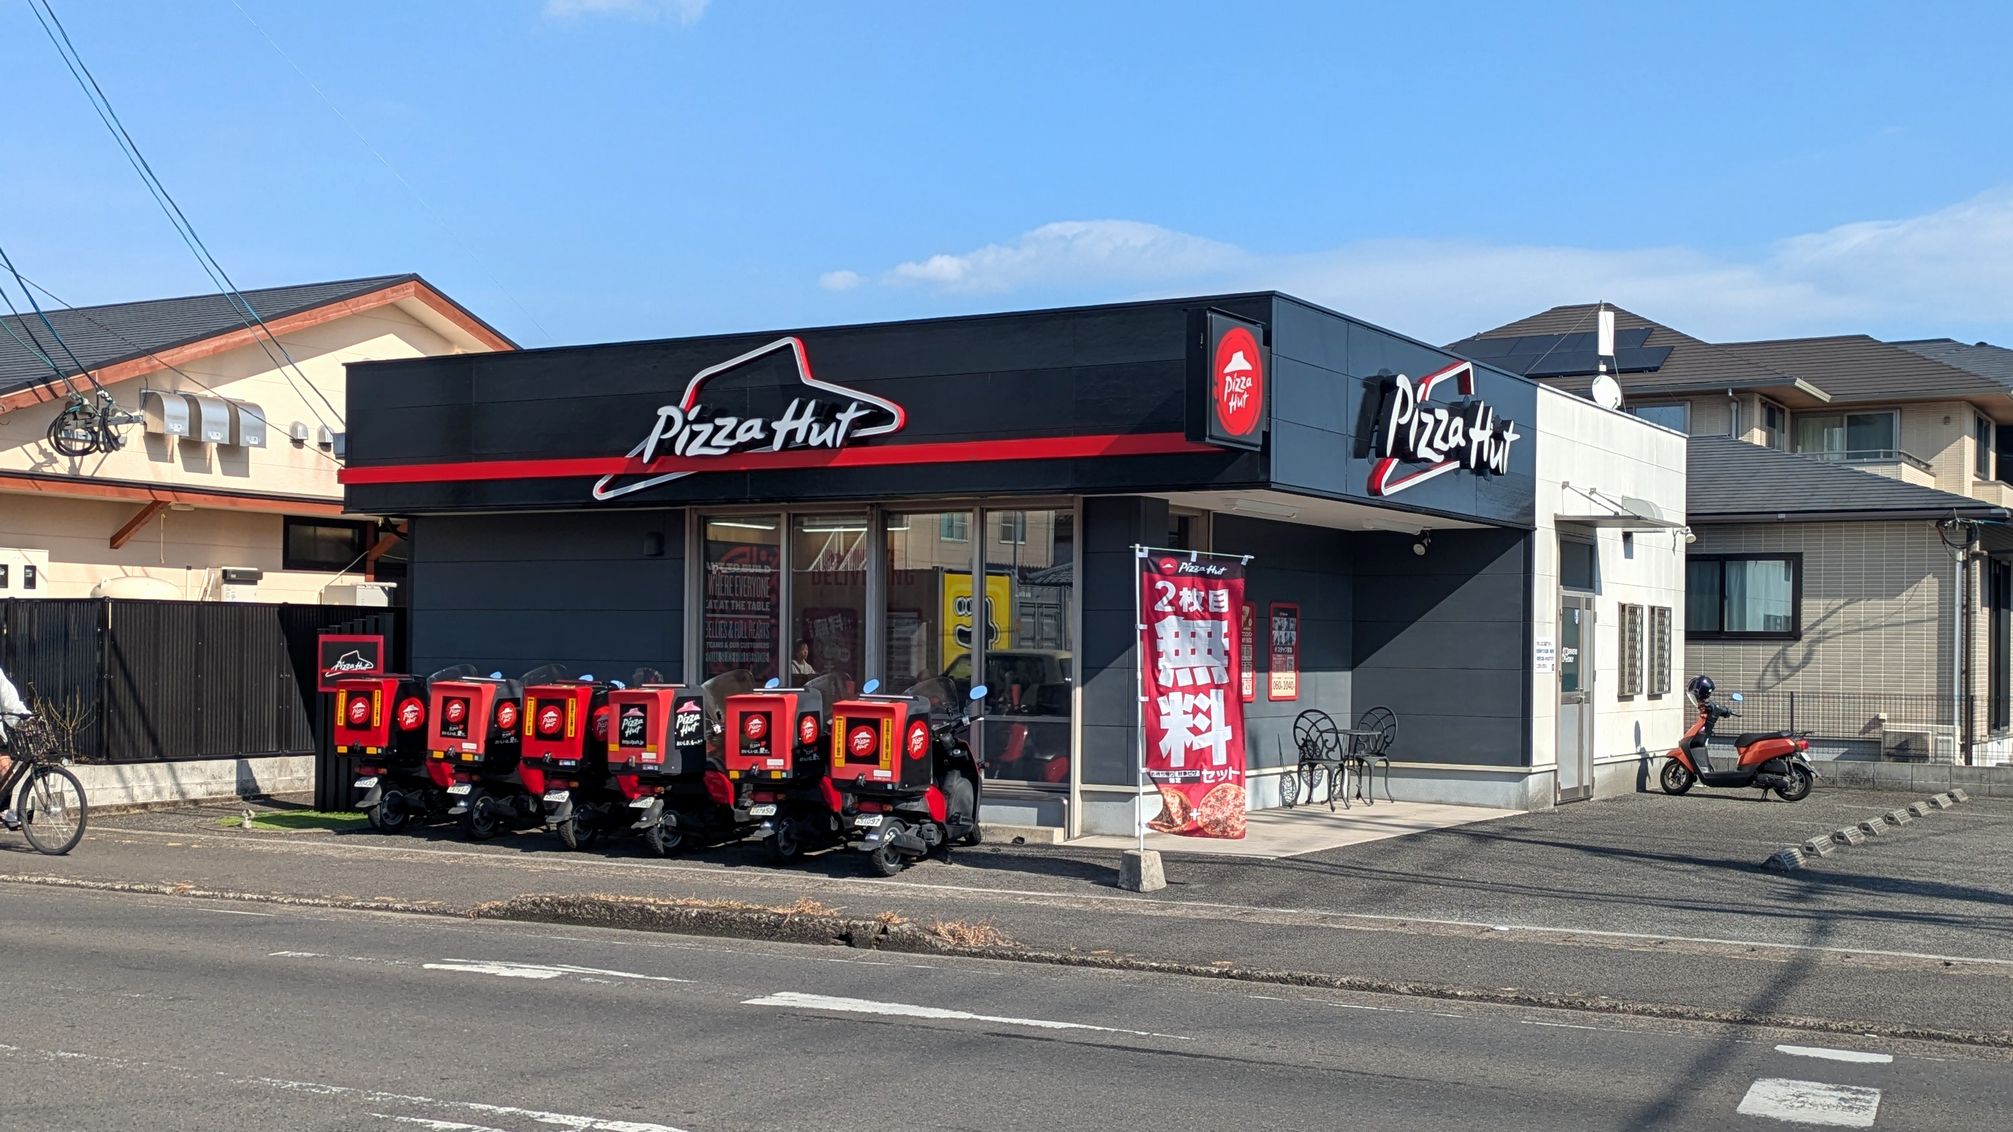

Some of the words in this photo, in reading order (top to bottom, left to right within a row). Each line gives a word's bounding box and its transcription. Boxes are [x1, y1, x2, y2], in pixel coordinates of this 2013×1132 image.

[1224, 372, 1252, 402] Pizza
[1229, 390, 1249, 414] Hut
[642, 404, 766, 464] Pizza
[770, 397, 872, 452] Hut
[1387, 373, 1466, 463] Pizza
[1469, 400, 1521, 475] Hut
[1179, 562, 1204, 573] Pizza
[1206, 564, 1228, 575] Hut
[708, 574, 733, 597] WHERE
[735, 575, 771, 598] EVERYONE
[1154, 580, 1229, 613] 2枚目
[731, 600, 746, 611] THE
[747, 601, 771, 612] TABLE
[335, 660, 355, 671] Pizza
[1154, 615, 1232, 768] 無料
[621, 717, 644, 730] Pizza
[676, 712, 701, 730] Pizza
[680, 721, 700, 738] Hut
[625, 725, 642, 738] Hut
[1202, 766, 1241, 784] セット
